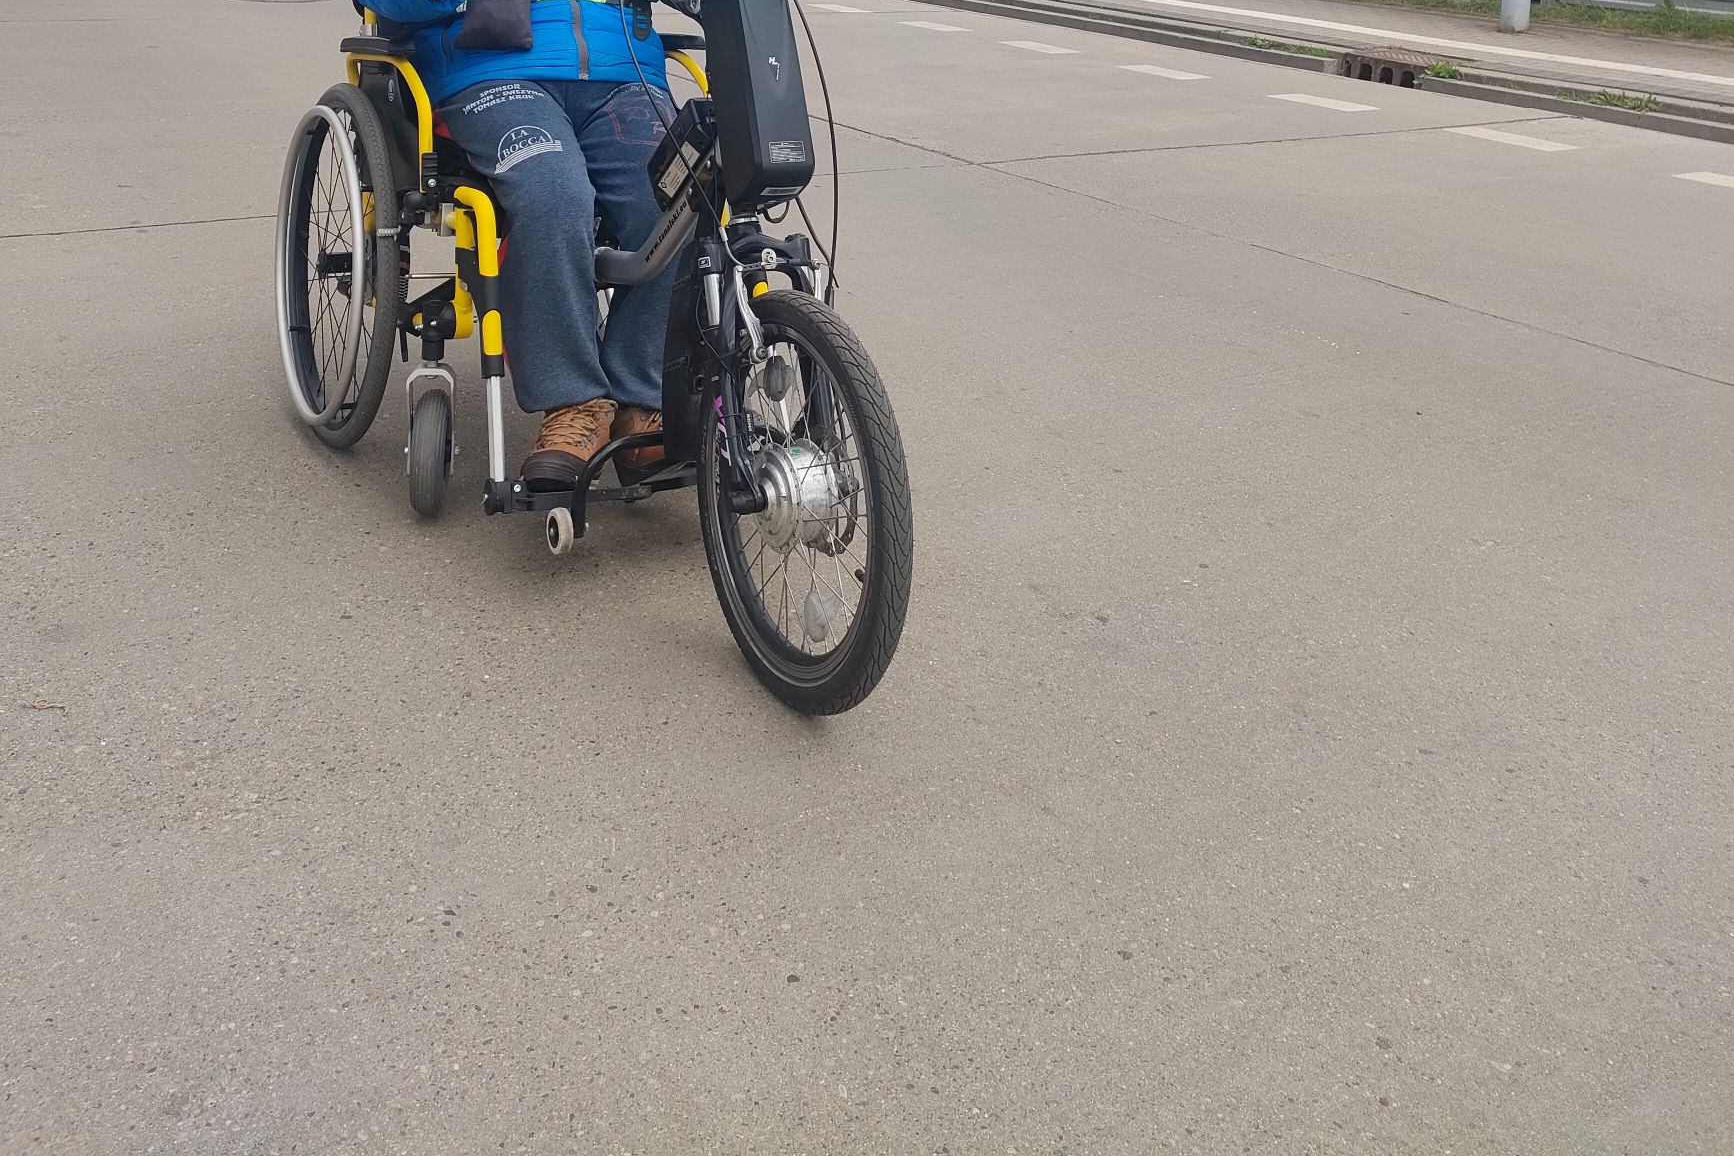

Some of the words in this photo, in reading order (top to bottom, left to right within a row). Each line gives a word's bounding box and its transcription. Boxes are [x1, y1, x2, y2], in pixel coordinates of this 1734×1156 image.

[479, 83, 521, 98] SPONSOR
[472, 96, 507, 114] TOMASZ
[510, 129, 529, 141] LA
[501, 135, 547, 158] BOCCA
